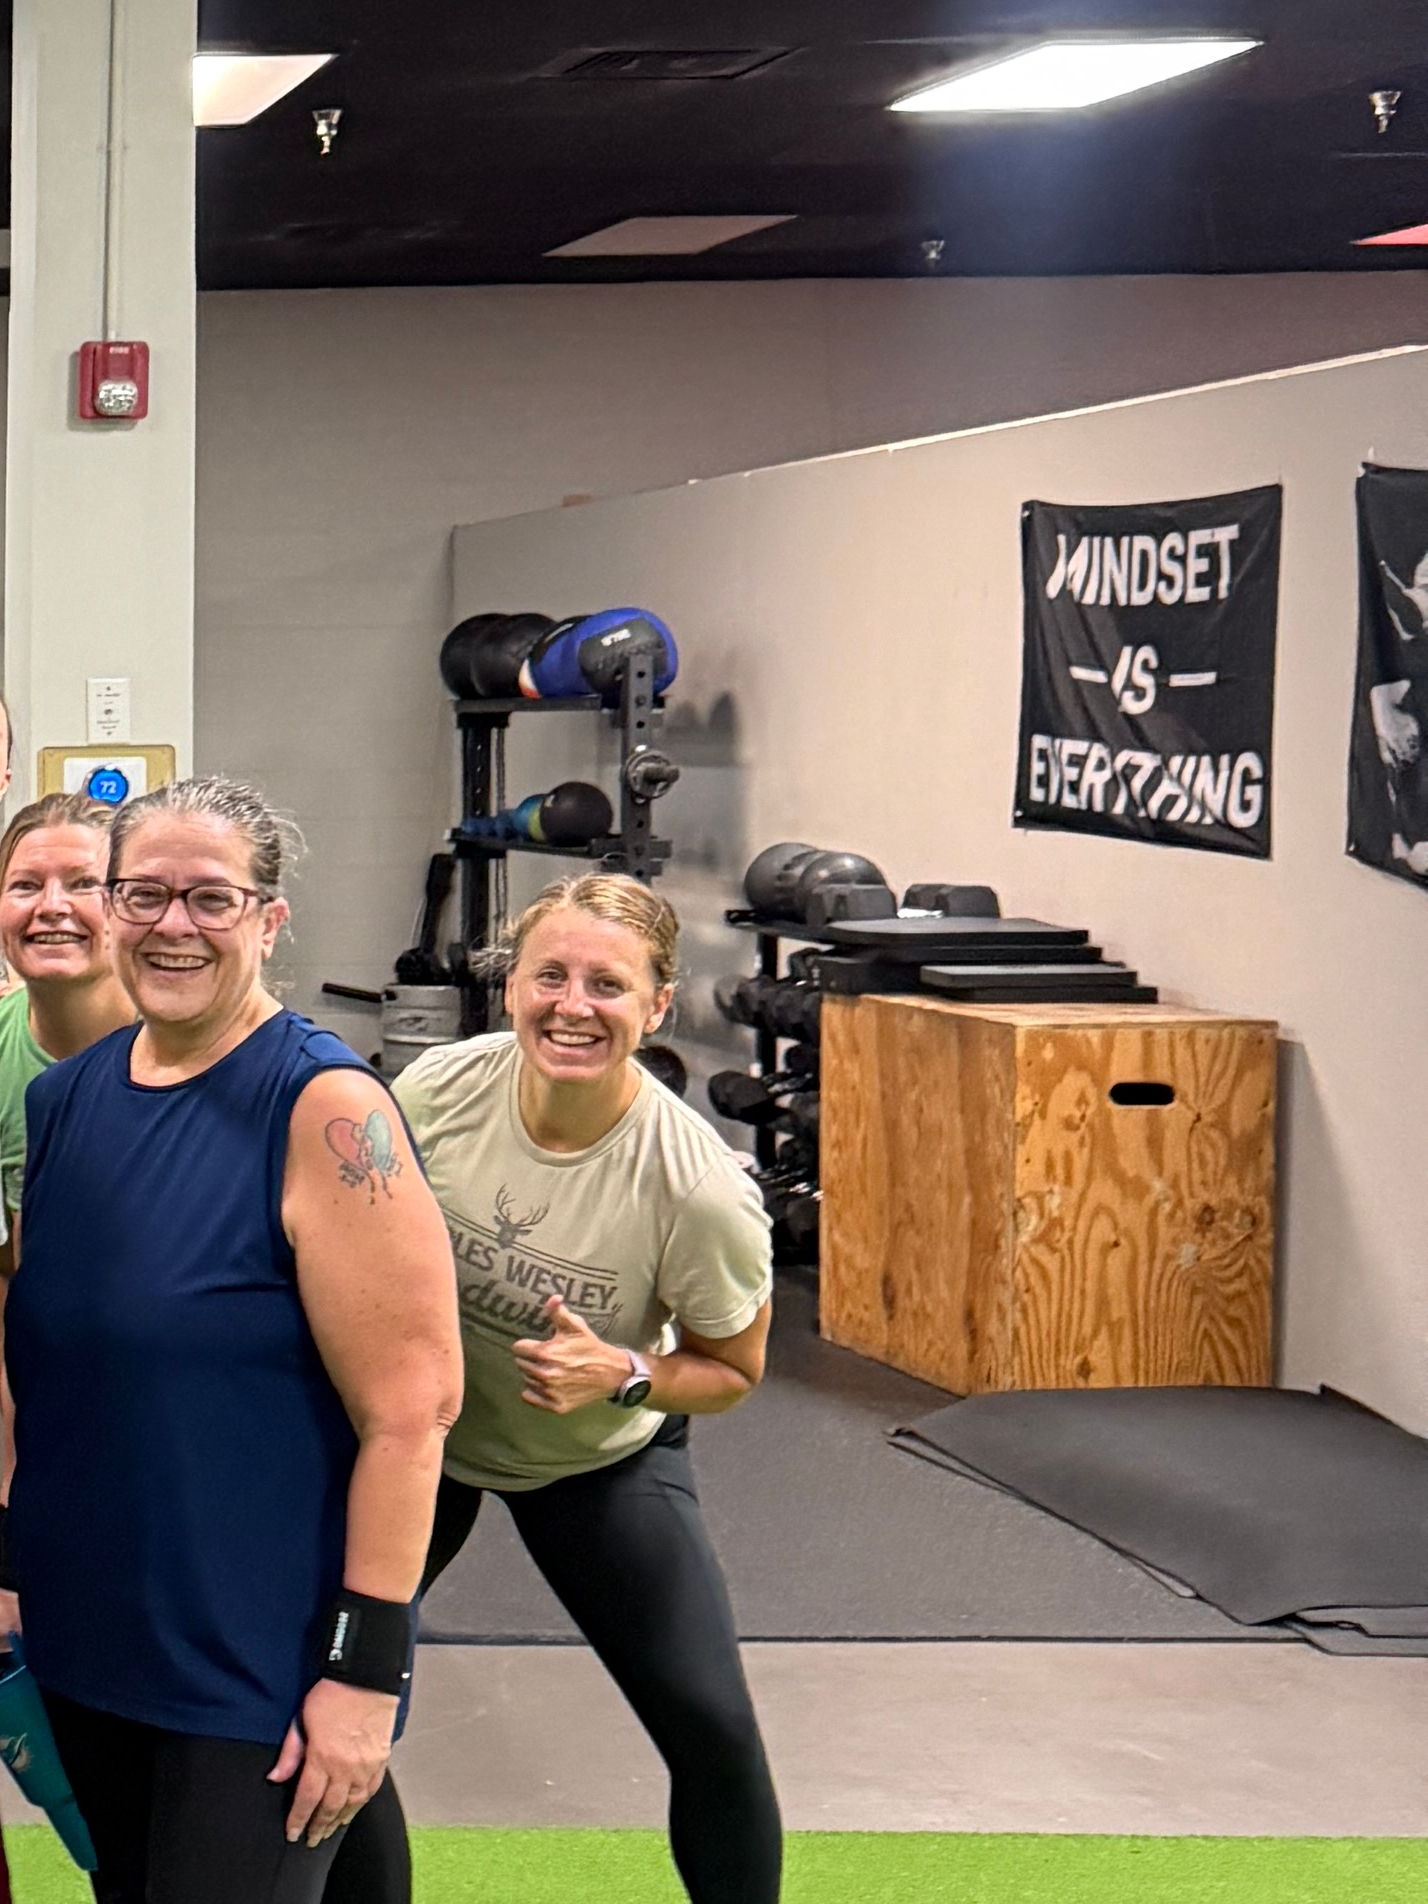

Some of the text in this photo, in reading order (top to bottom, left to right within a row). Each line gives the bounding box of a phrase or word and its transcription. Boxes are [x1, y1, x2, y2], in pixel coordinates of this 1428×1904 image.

[1046, 524, 1239, 607] MINDSET
[1111, 646, 1158, 715] IS
[100, 781, 117, 794] 72
[1029, 733, 1263, 827] EVERYTHING
[448, 1227, 498, 1272] LES
